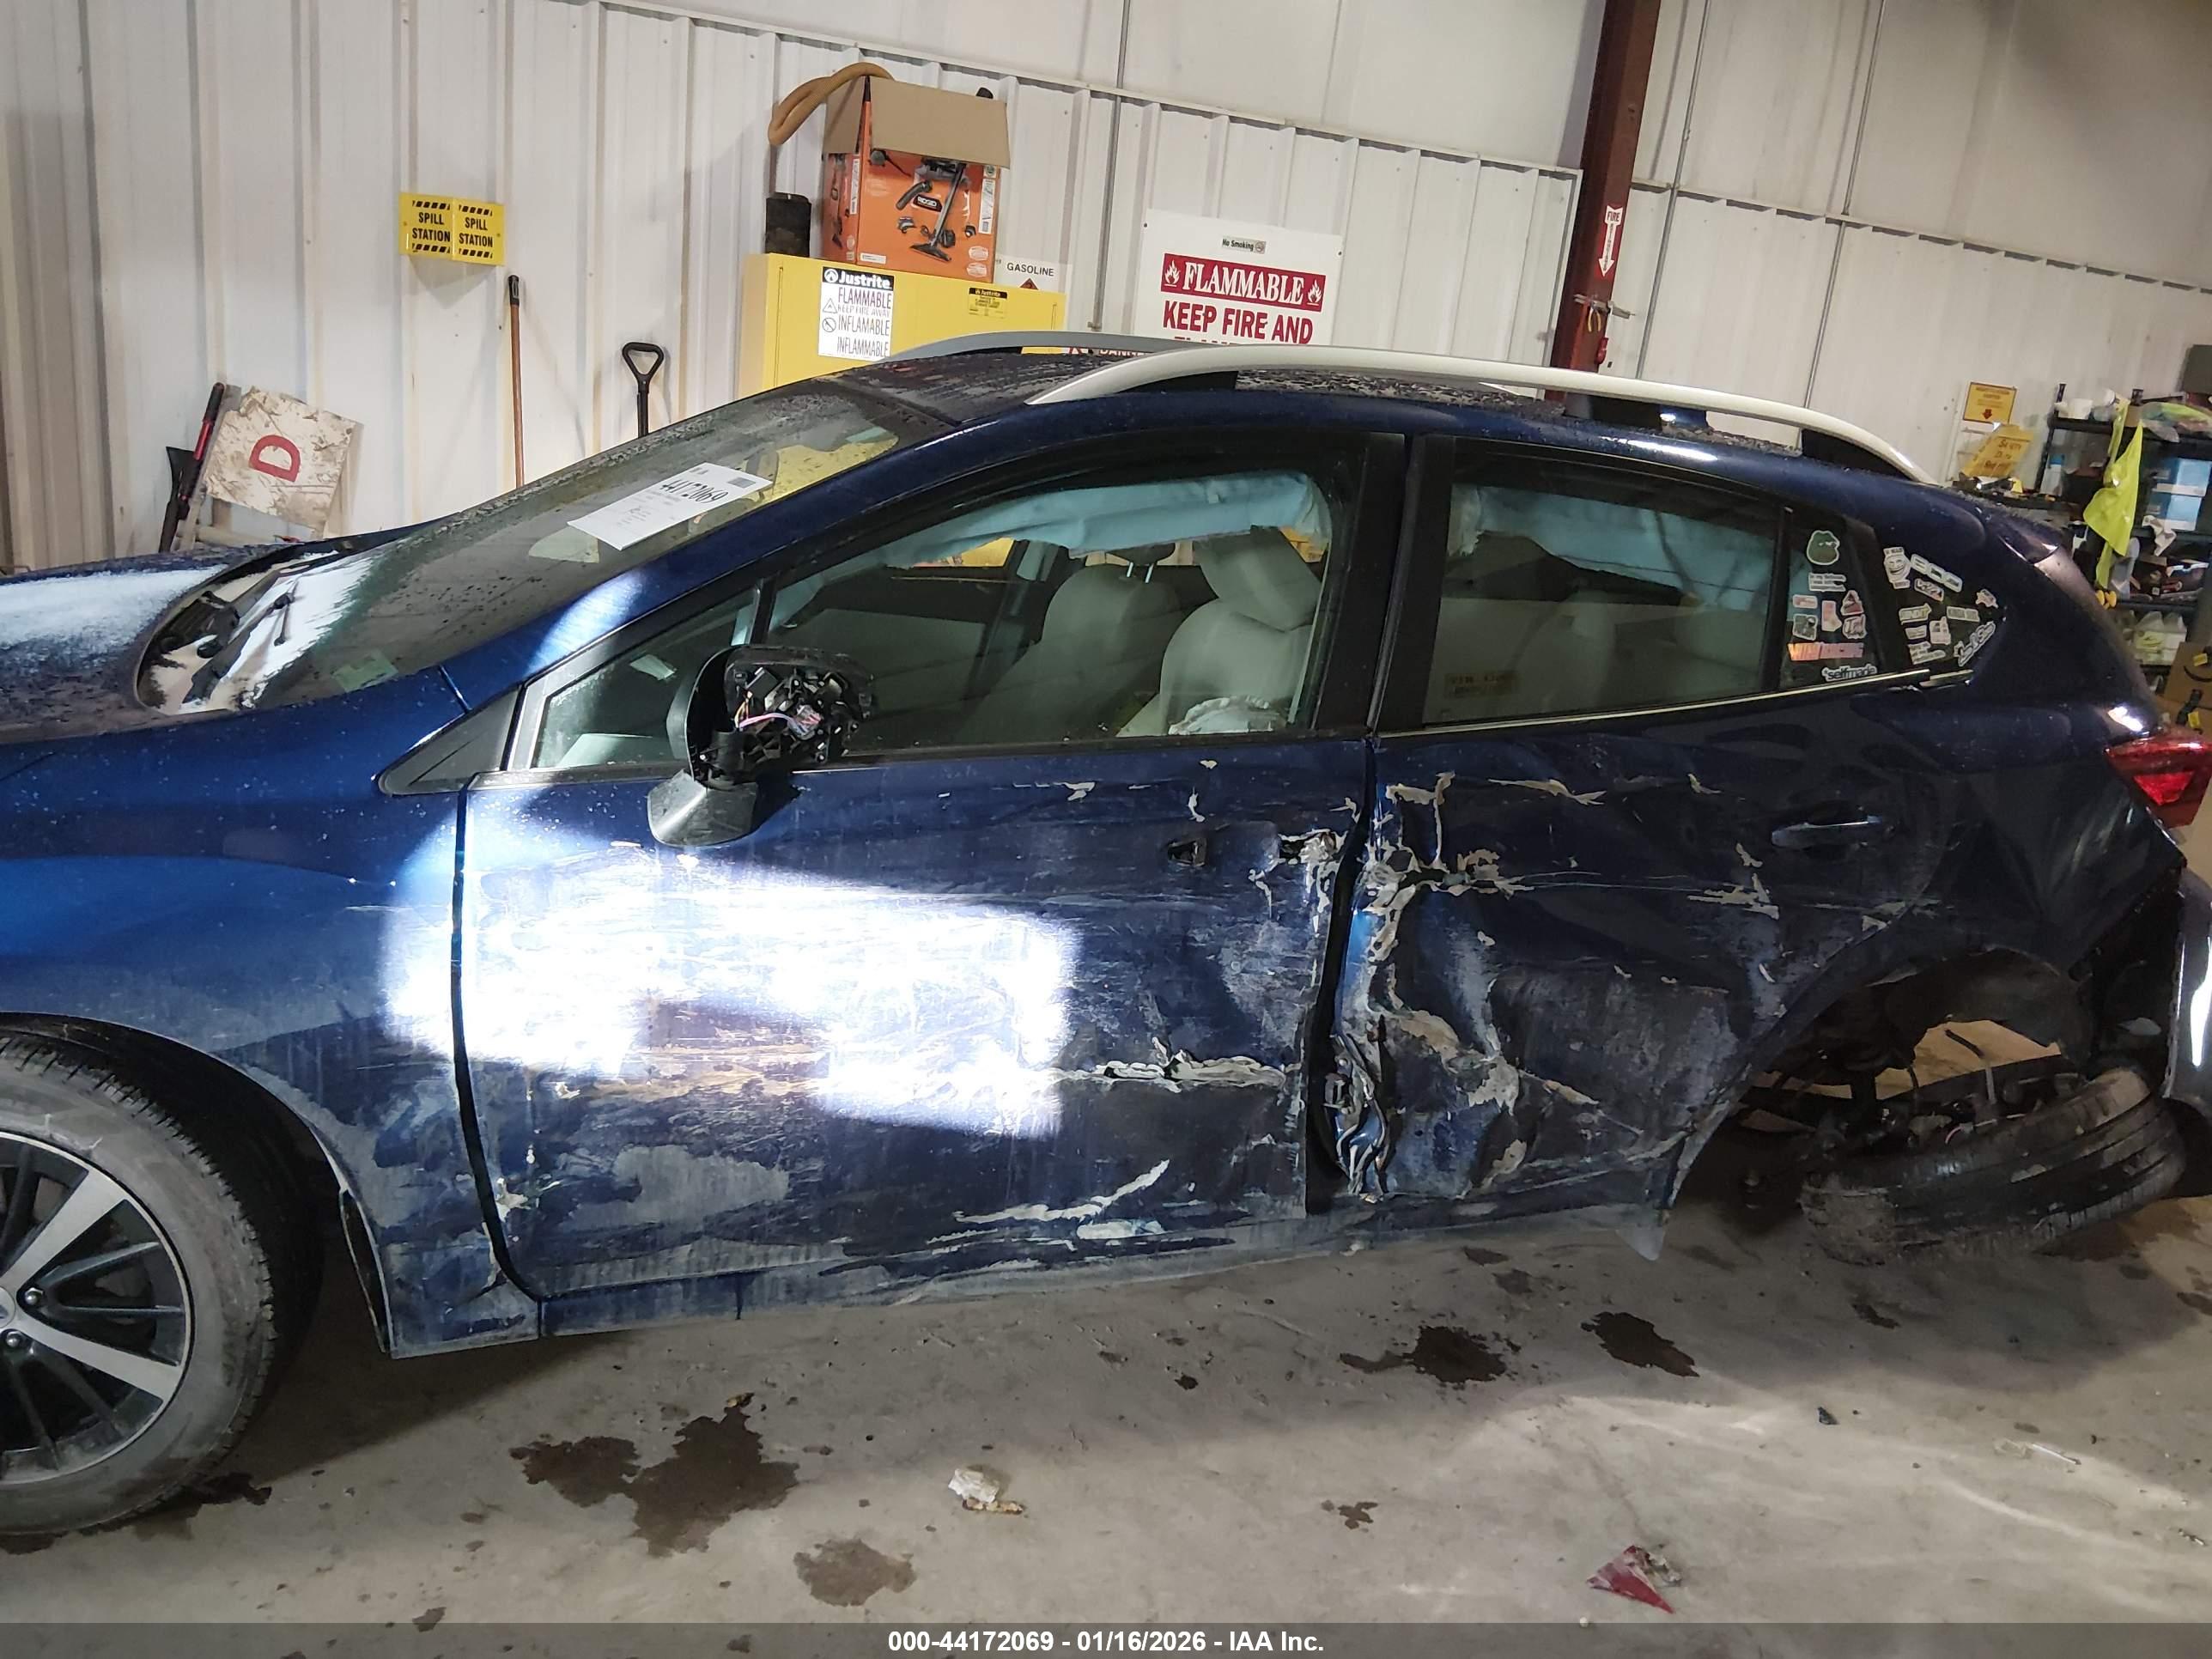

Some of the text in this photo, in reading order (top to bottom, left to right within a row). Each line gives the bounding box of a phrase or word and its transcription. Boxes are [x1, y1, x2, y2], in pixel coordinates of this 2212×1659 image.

[418, 212, 444, 225] SPILL
[465, 217, 488, 231] SPILL
[1607, 211, 1620, 222] FIRE
[412, 228, 450, 242] STATION
[459, 233, 493, 247] STATION
[1231, 240, 1254, 252] Smoking
[1006, 262, 1054, 276] GASOLINE
[839, 270, 890, 289] Justrite
[1182, 262, 1304, 305] FLAMMABLE
[838, 287, 892, 309] FLAMMABLE
[837, 304, 854, 314] KEEP
[838, 314, 890, 336] INFLAMABLE
[1163, 301, 1313, 344] KEEP FIRE AND
[837, 337, 889, 357] INFLAMMABLE
[248, 434, 301, 483] D
[659, 479, 728, 503] 44172069
